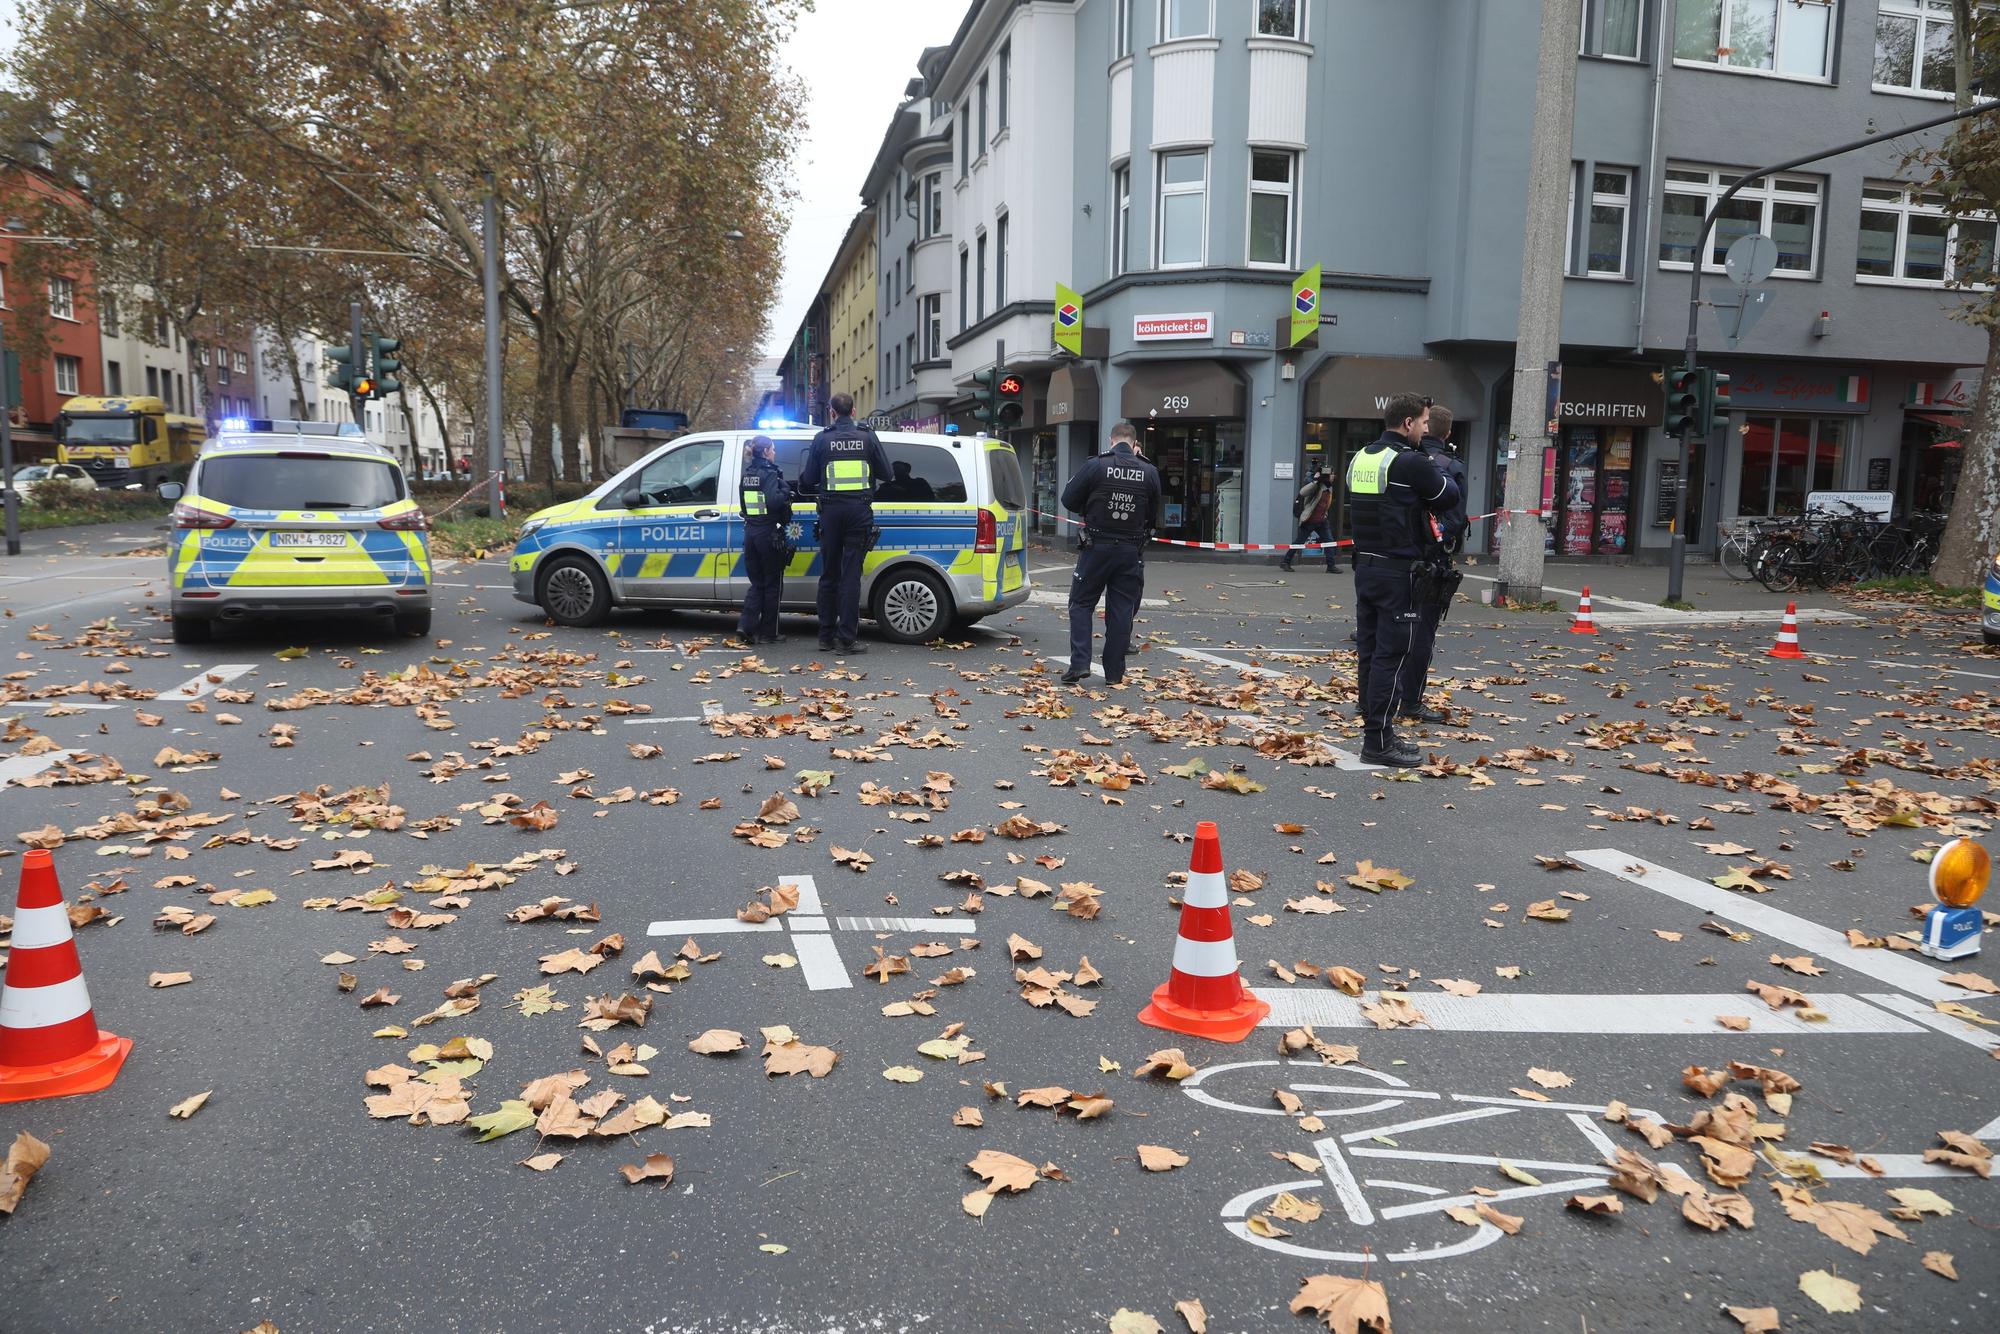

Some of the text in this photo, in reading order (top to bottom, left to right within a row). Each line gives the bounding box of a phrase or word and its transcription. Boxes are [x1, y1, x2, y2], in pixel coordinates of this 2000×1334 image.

[1163, 396, 1189, 409] 269
[830, 440, 864, 451] POLIZEI
[1106, 466, 1145, 482] POLIZEI
[1353, 470, 1376, 483] POLIZEI
[743, 476, 760, 487] POLIZEI
[1111, 492, 1134, 503] NRW
[1107, 501, 1136, 512] 31452
[277, 532, 345, 545] NRW 4-9827
[641, 526, 705, 541] POLIZEI
[203, 537, 251, 548] POLIZEI
